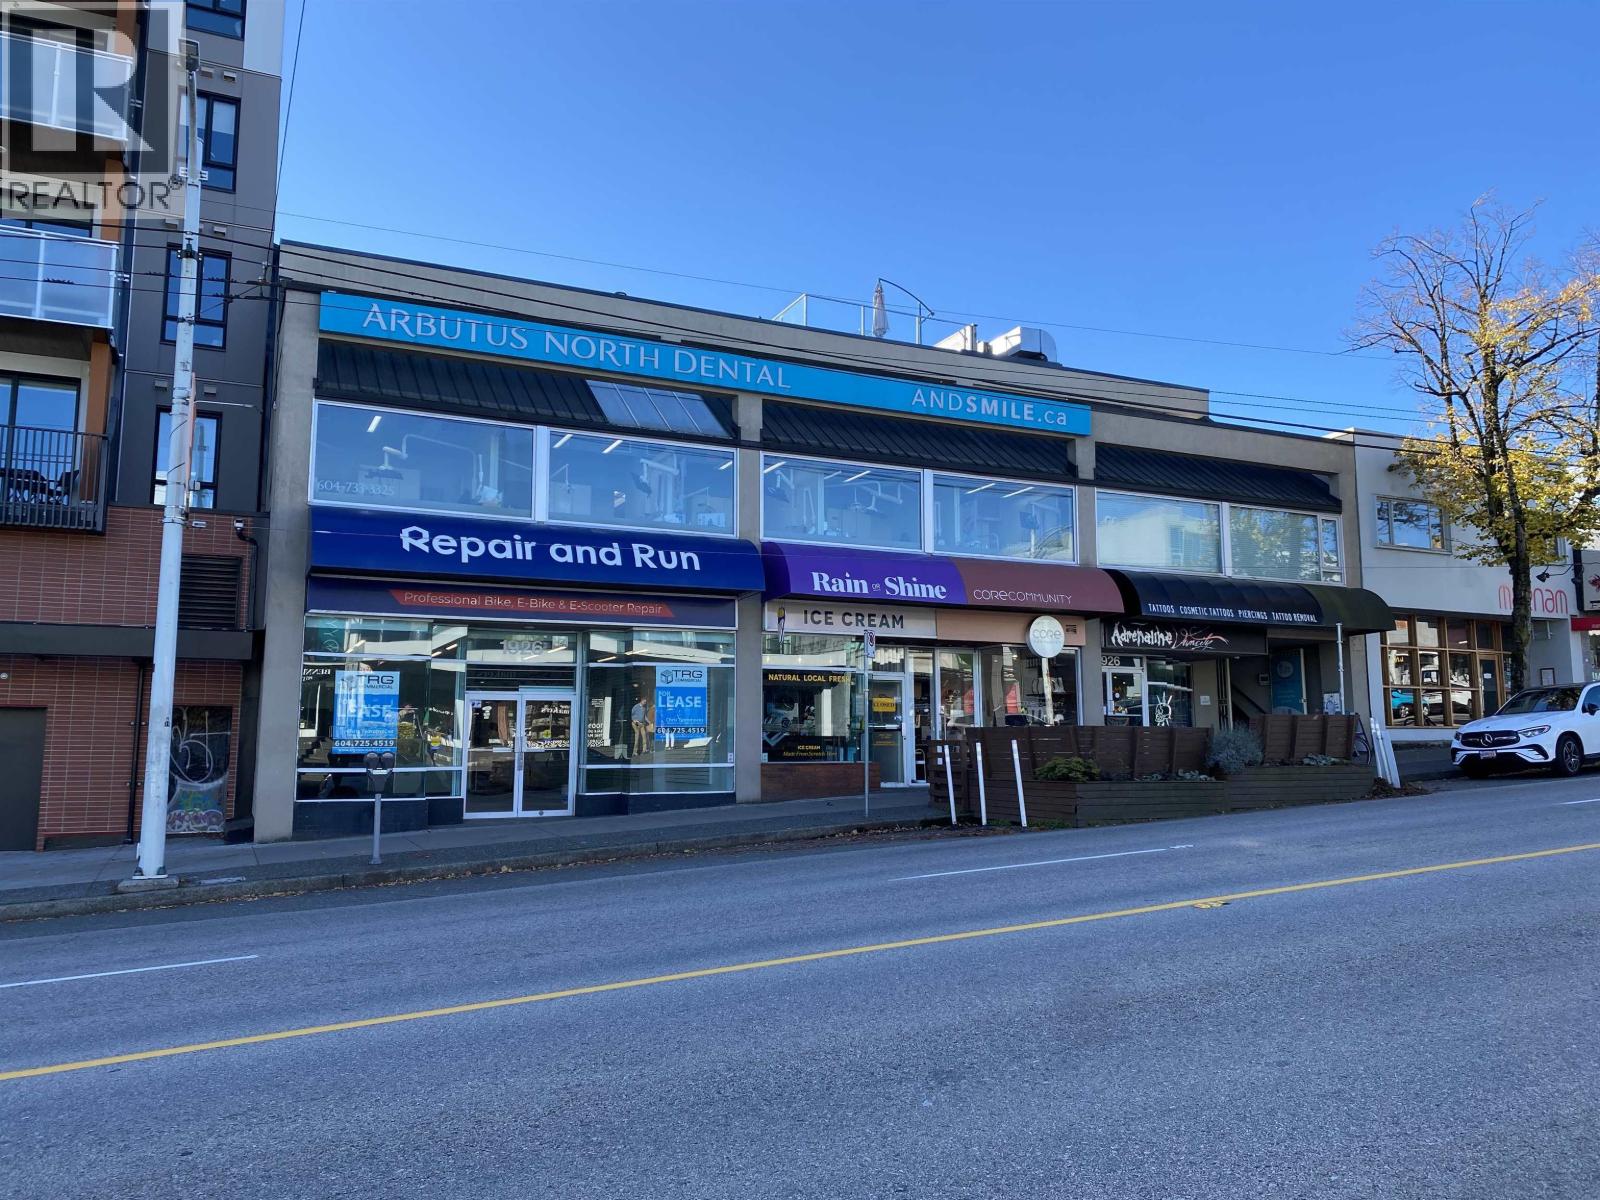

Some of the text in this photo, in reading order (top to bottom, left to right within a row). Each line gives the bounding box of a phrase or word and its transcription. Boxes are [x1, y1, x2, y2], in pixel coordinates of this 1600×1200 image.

[362, 303, 791, 389] ARBUTUS NORTH DENTAL
[912, 388, 1067, 426] ANDSMILE.ca
[400, 525, 701, 571] Repair and Run
[811, 571, 869, 594] Rain
[884, 576, 947, 599] Shine
[404, 591, 481, 606] Professional
[517, 597, 555, 610] E-Bike
[558, 600, 566, 610] &
[569, 600, 624, 613] E-Scooter
[627, 603, 663, 616] Repair
[1148, 603, 1317, 623] TATTOOS COSMETIC TATTOOS PIERCINGS TATTOO REMOVAL
[803, 609, 904, 629] ICE CREAM
[1111, 621, 1173, 647] Adrenaline
[500, 639, 544, 655] 1926
[672, 669, 703, 678] TRG
[768, 673, 800, 681] NATURAL
[803, 674, 826, 682] LOCAL
[657, 696, 702, 708] LEASE
